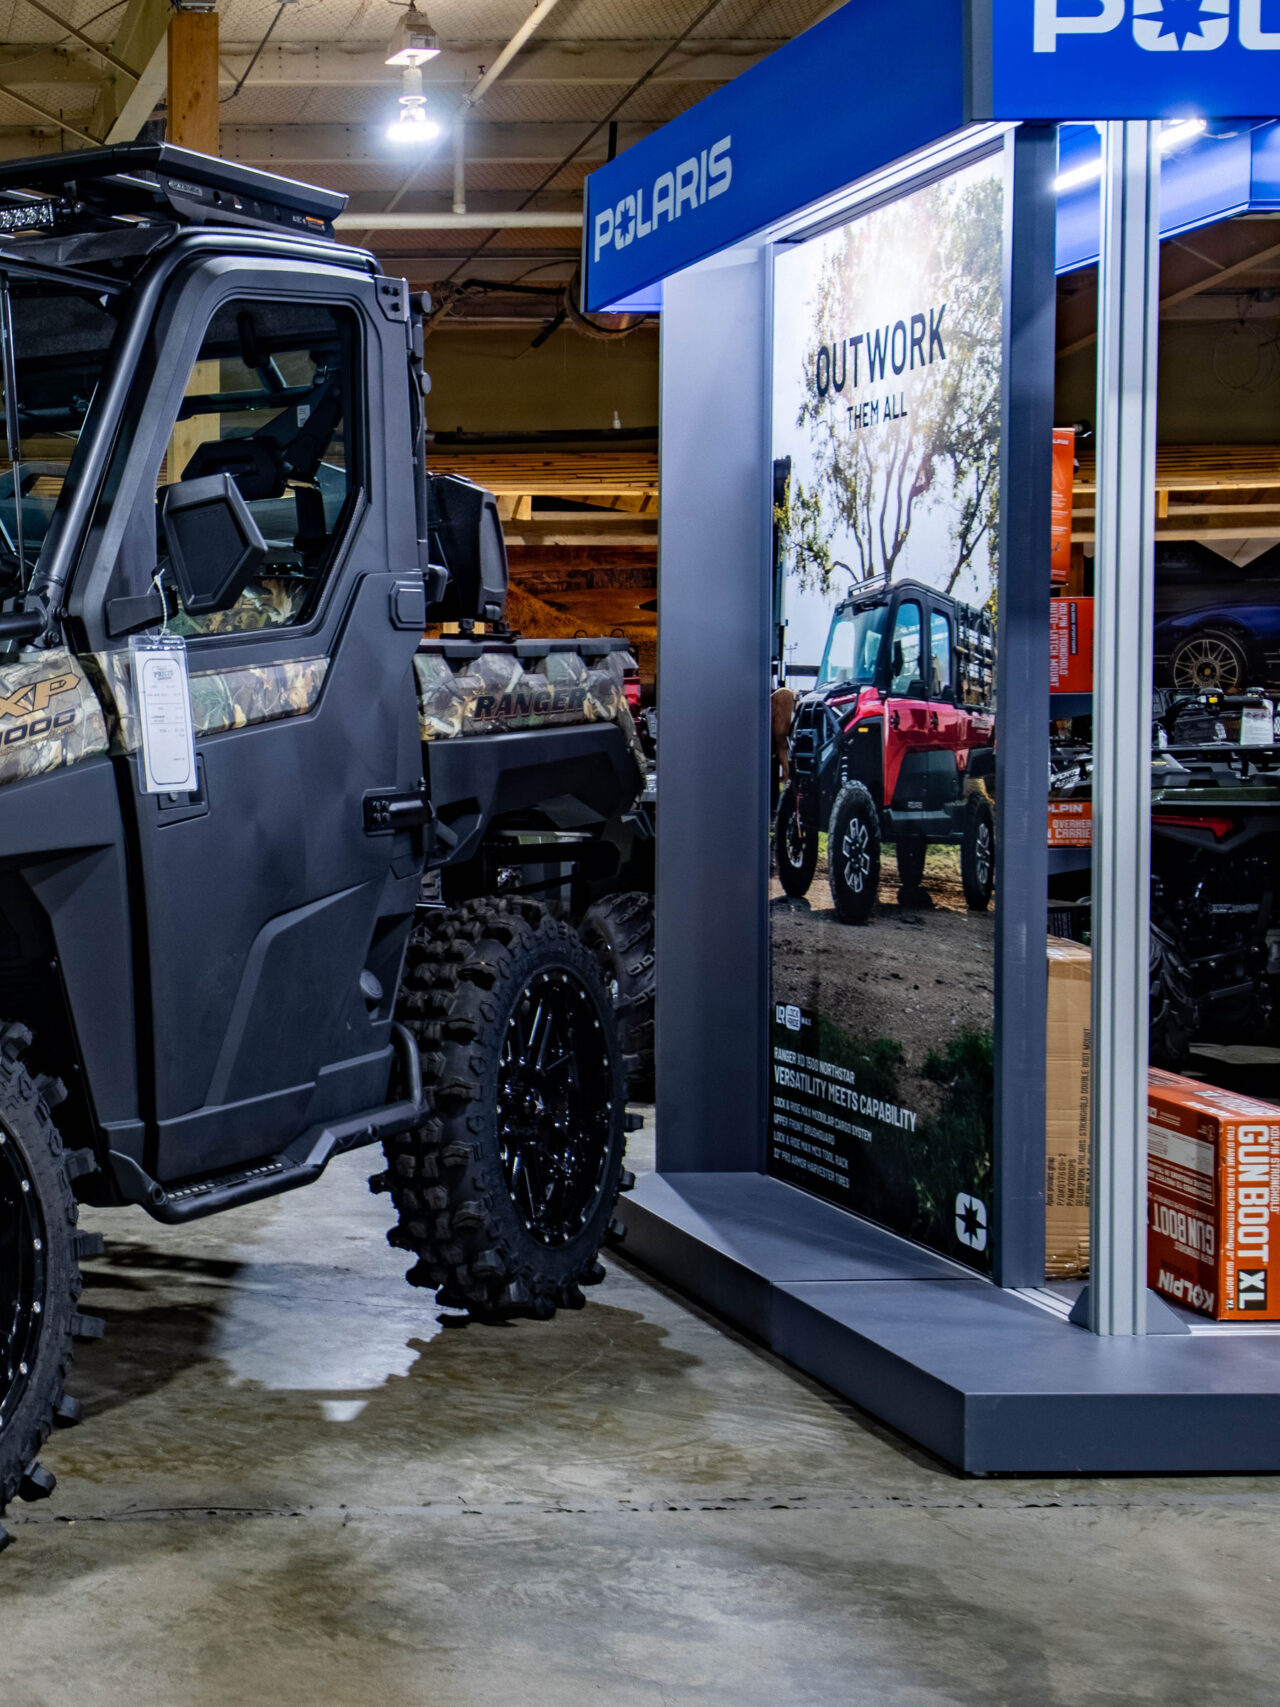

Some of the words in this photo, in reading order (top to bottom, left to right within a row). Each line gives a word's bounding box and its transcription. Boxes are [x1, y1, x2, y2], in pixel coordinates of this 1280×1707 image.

[593, 135, 732, 263] POLARIS
[816, 304, 948, 398] OUTWORK
[846, 400, 880, 431] THEM
[883, 392, 908, 422] ALL
[1050, 603, 1059, 656] AUTO-LATCH
[1059, 603, 1068, 626] KOLPIN
[1050, 658, 1059, 687] MOUNT
[1059, 629, 1068, 674] STRONGHOLD
[473, 687, 588, 721] RANGER
[774, 1046, 796, 1064] RANGER
[819, 1060, 856, 1085] NORTHSTAR
[774, 1065, 828, 1099] VERSATILITY
[828, 1083, 859, 1112] MEETS
[859, 1095, 917, 1132] CAPABILITY
[1237, 1125, 1270, 1182] GUN
[1271, 1125, 1280, 1155] KOLPIN
[1226, 1187, 1235, 1211] KOLPIN
[1270, 1157, 1280, 1214] STRONGHOLD
[1152, 1202, 1186, 1244] BOOT
[1188, 1216, 1214, 1256] GUN
[1237, 1187, 1270, 1263] BOOT
[1157, 1268, 1215, 1312] KOLPIN
[1239, 1271, 1266, 1309] XL
